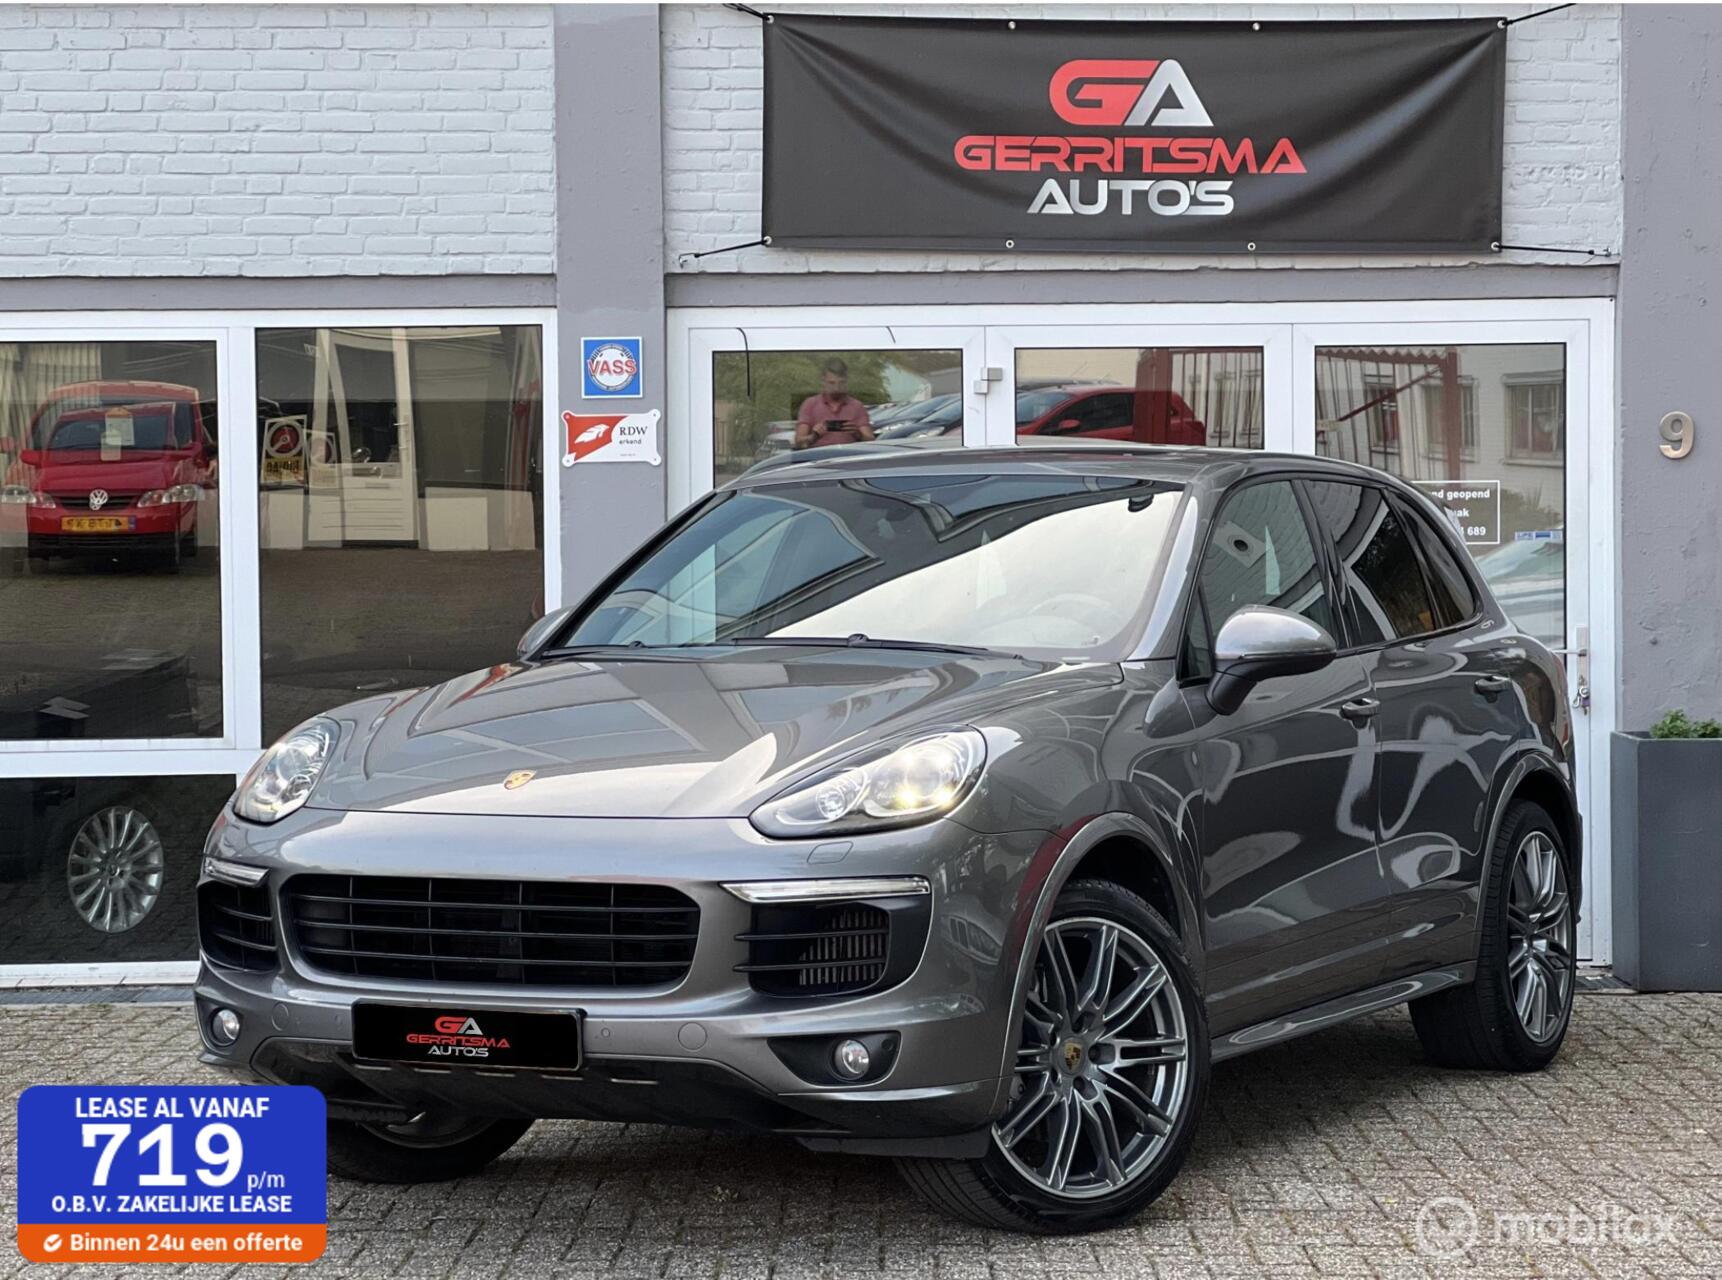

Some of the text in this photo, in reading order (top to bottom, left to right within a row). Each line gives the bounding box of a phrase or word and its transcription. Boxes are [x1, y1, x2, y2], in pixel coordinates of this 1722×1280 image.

[1049, 58, 1215, 127] GA
[954, 135, 1307, 175] GERRITSMA
[1026, 178, 1235, 217] AUTO'S
[588, 359, 637, 376] VASS
[619, 426, 648, 436] RDW
[1659, 411, 1694, 459] 9
[1447, 488, 1490, 501] geopend
[1455, 508, 1470, 517] ak
[1467, 526, 1486, 536] 689
[434, 1016, 484, 1035] GA
[406, 1033, 510, 1049] GERRITSMA
[427, 1045, 489, 1058] AUTO'S
